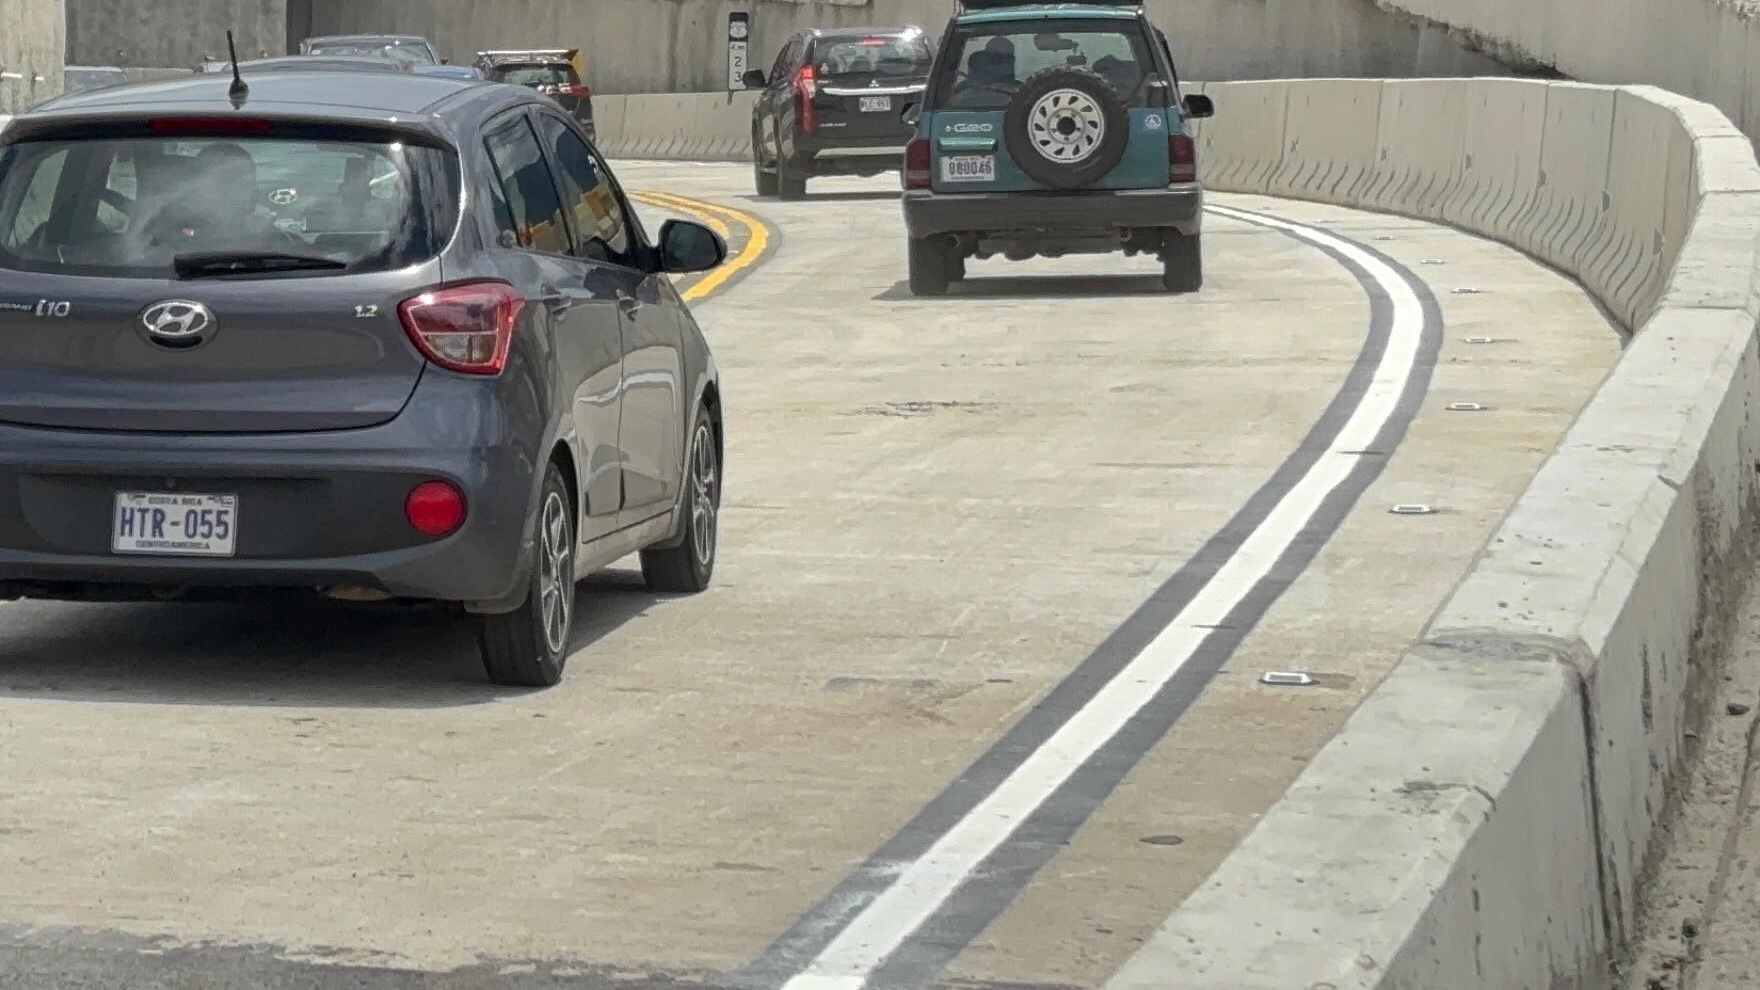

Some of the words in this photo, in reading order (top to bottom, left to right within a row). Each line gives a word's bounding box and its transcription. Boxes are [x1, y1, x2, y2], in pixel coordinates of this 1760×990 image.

[734, 56, 742, 67] 2
[734, 71, 742, 83] 3
[120, 506, 229, 540] HTR-055
